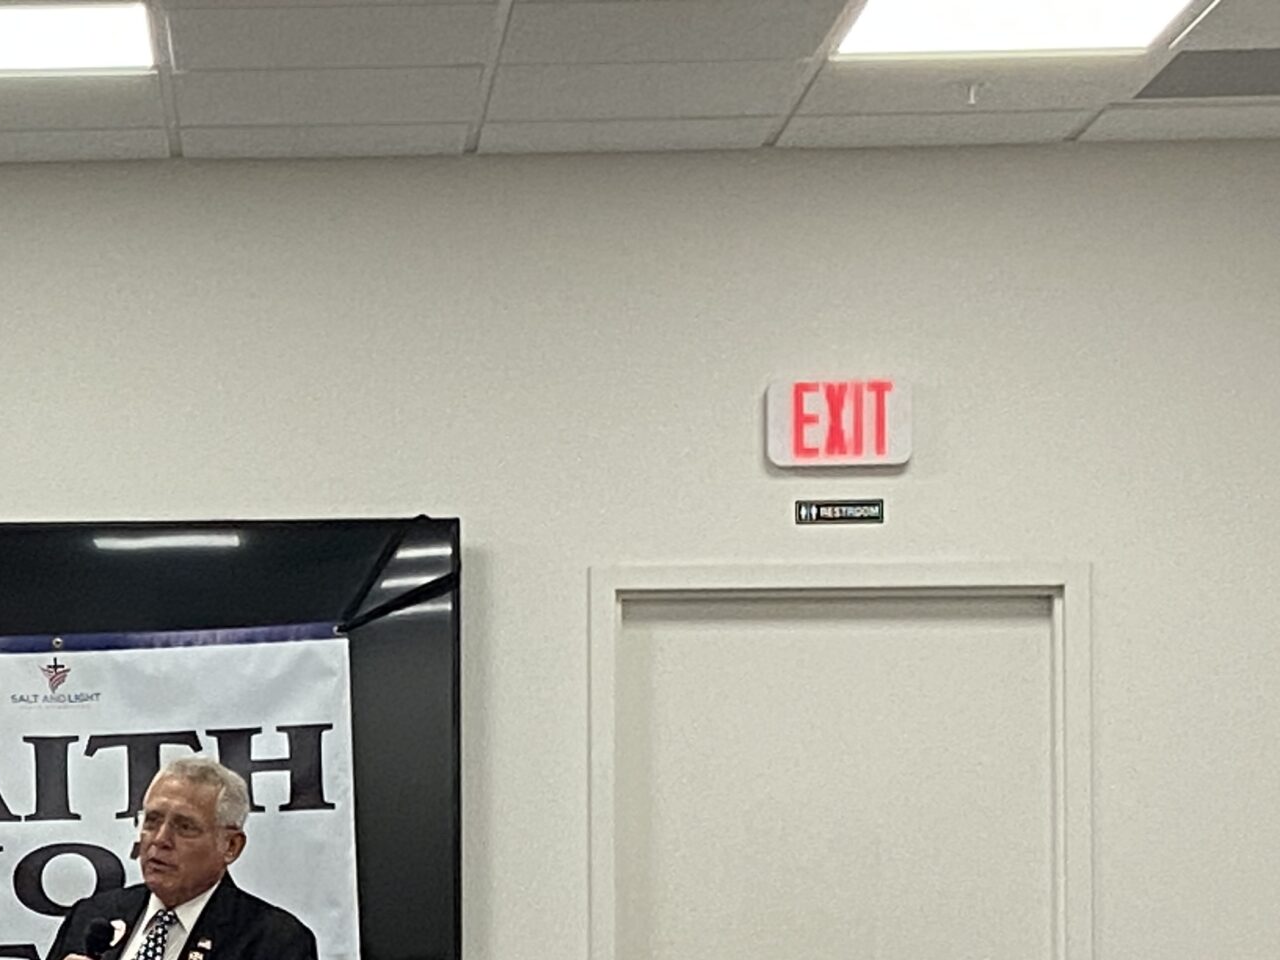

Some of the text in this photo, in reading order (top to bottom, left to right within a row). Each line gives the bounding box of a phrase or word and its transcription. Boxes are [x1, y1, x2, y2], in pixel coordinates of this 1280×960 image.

[792, 380, 894, 459] EXIT
[819, 505, 880, 520] RESTROOM
[10, 692, 101, 704] SALT AND LIGHT
